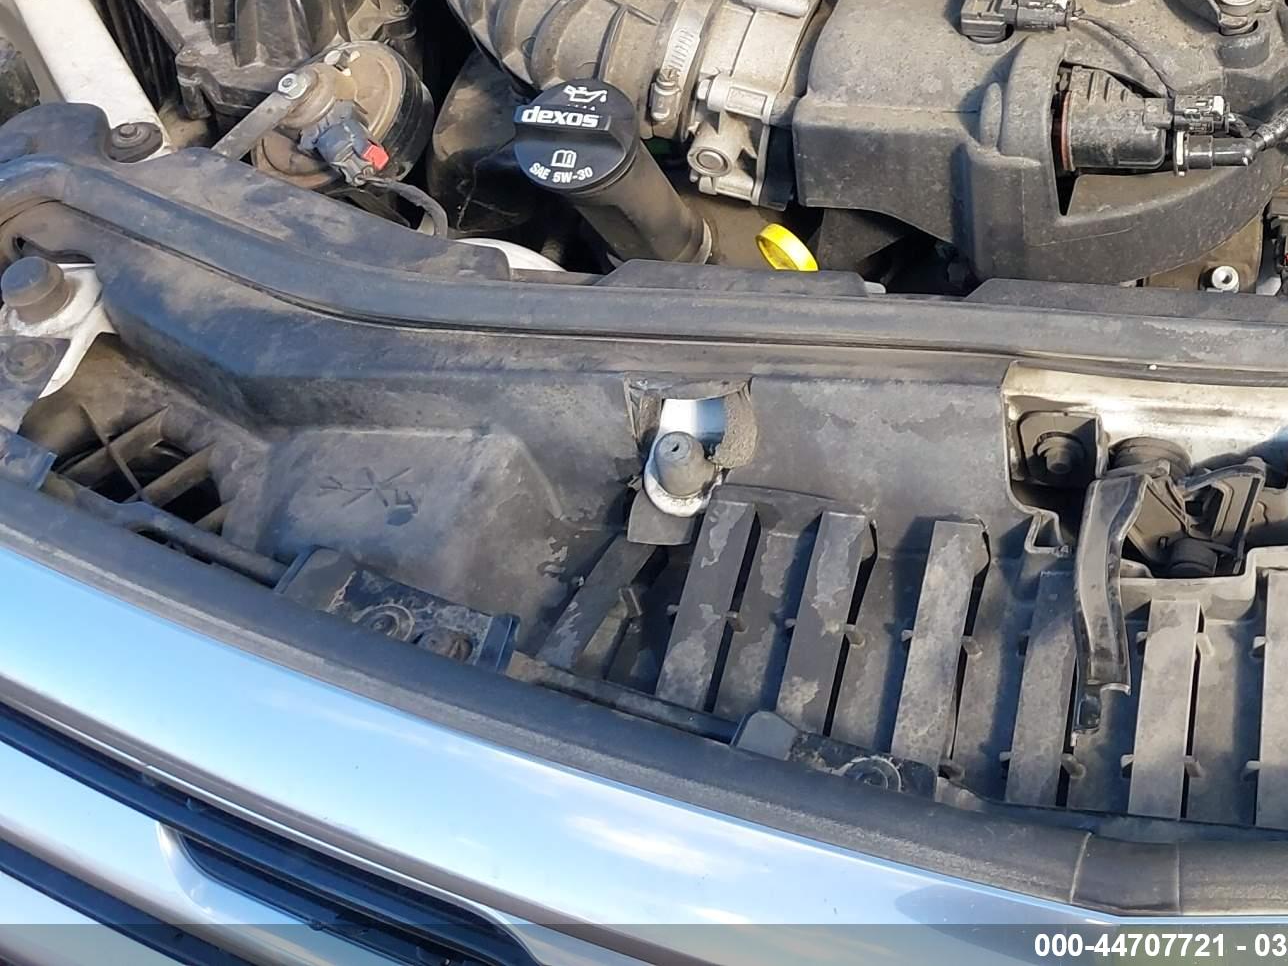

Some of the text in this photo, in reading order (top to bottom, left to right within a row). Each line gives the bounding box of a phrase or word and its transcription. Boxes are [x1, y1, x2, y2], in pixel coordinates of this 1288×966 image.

[521, 106, 599, 128] dexos
[529, 162, 594, 184] SAE 5W-30
